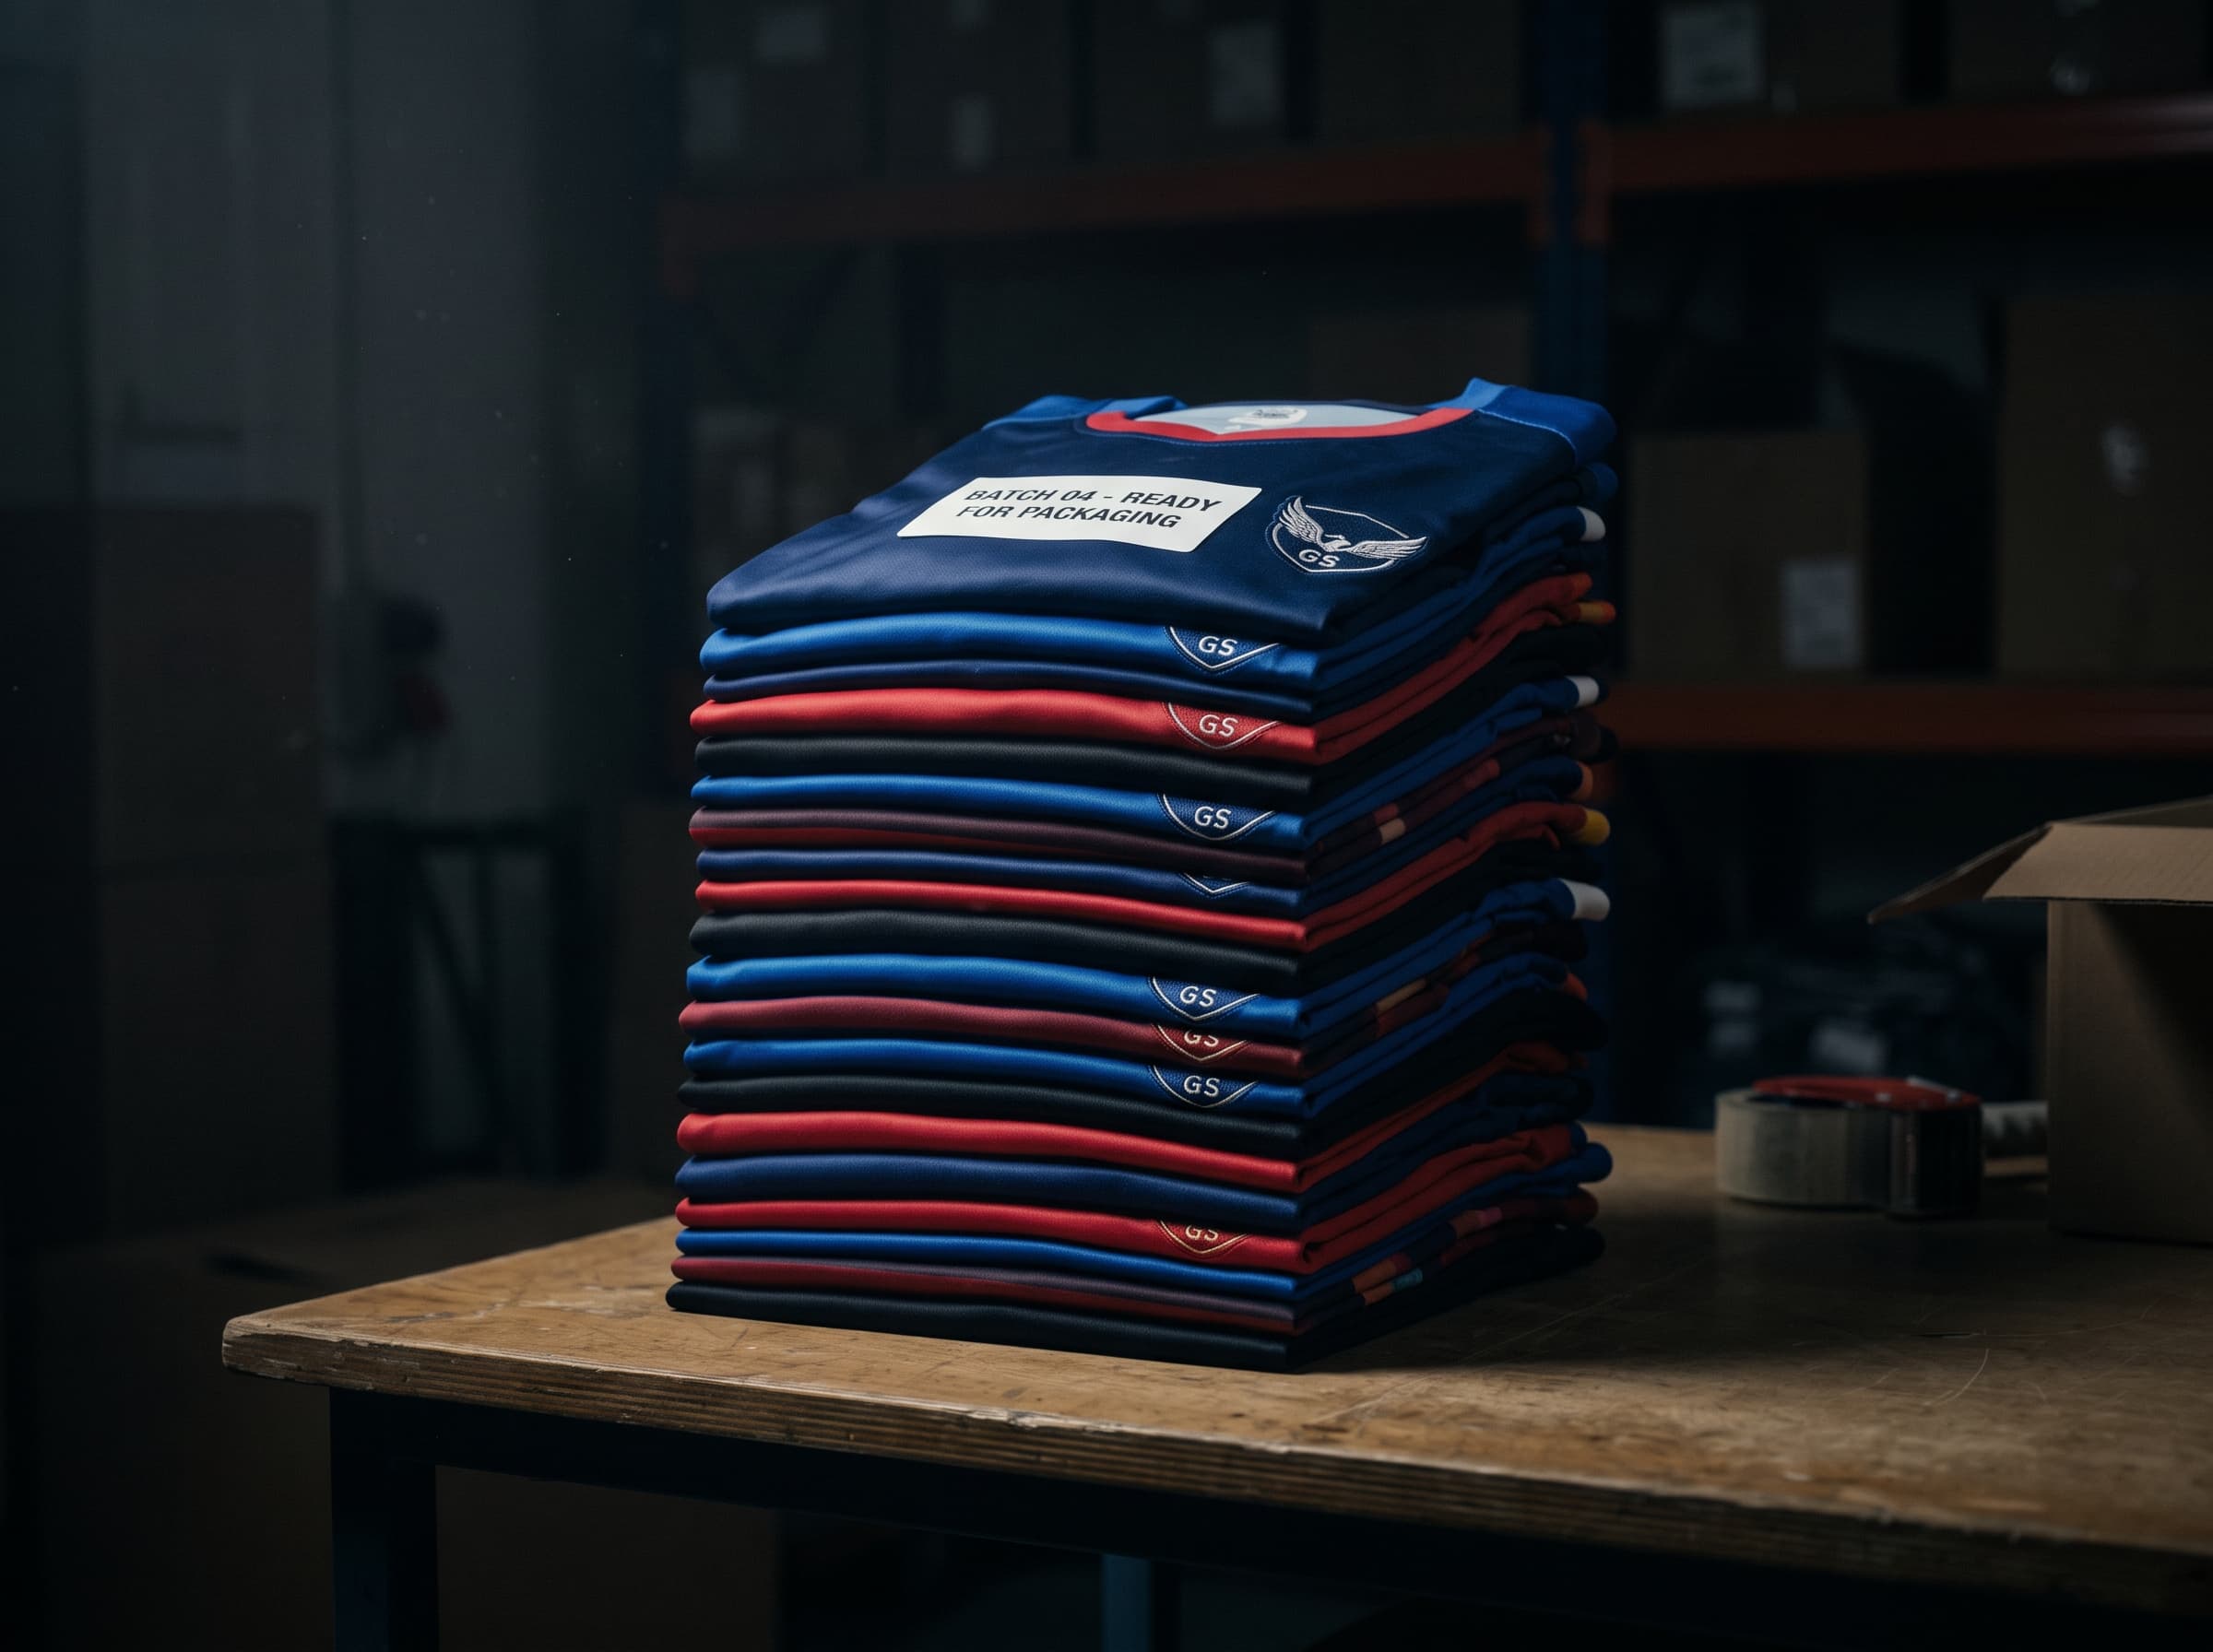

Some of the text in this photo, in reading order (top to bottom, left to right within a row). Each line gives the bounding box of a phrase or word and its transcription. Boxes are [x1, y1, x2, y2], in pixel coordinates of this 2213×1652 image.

[964, 490, 1059, 502] BATCH
[1060, 490, 1096, 502] 04
[1119, 491, 1223, 513] READY
[956, 506, 1182, 528] FOR PACKAGING
[1298, 549, 1340, 568] GS
[1199, 635, 1237, 656] GS
[1199, 714, 1238, 738] GS
[1194, 806, 1232, 830] GS
[1179, 985, 1217, 1008] GS
[1183, 1075, 1221, 1097] GS
